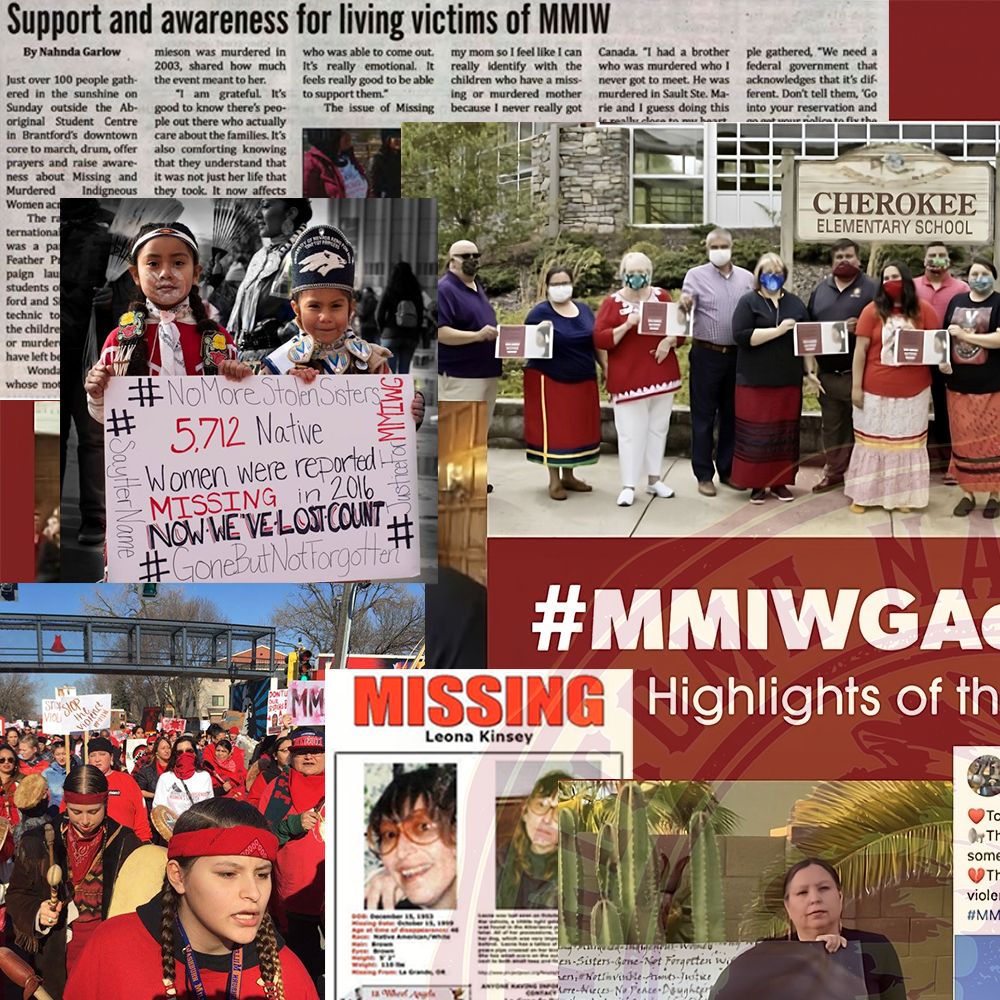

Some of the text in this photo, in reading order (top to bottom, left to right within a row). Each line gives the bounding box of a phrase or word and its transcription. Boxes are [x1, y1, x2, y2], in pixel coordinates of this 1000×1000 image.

[8, 2, 610, 41] Support and awareness for living victims of MMIW
[24, 47, 121, 59] By Nahnda Garlow
[7, 75, 25, 86] Just
[55, 75, 72, 84] 100
[76, 75, 109, 86] people
[112, 75, 137, 86] gath-
[812, 192, 977, 216] CHEROKEE
[818, 219, 972, 234] ELEMENTARY SCHOOL
[171, 412, 324, 453] 5,712 Native
[145, 446, 377, 492] Women were reported
[150, 475, 374, 520] MISSING in 2016
[354, 675, 605, 727] MISSING
[426, 730, 533, 744] Leona Kinsey
